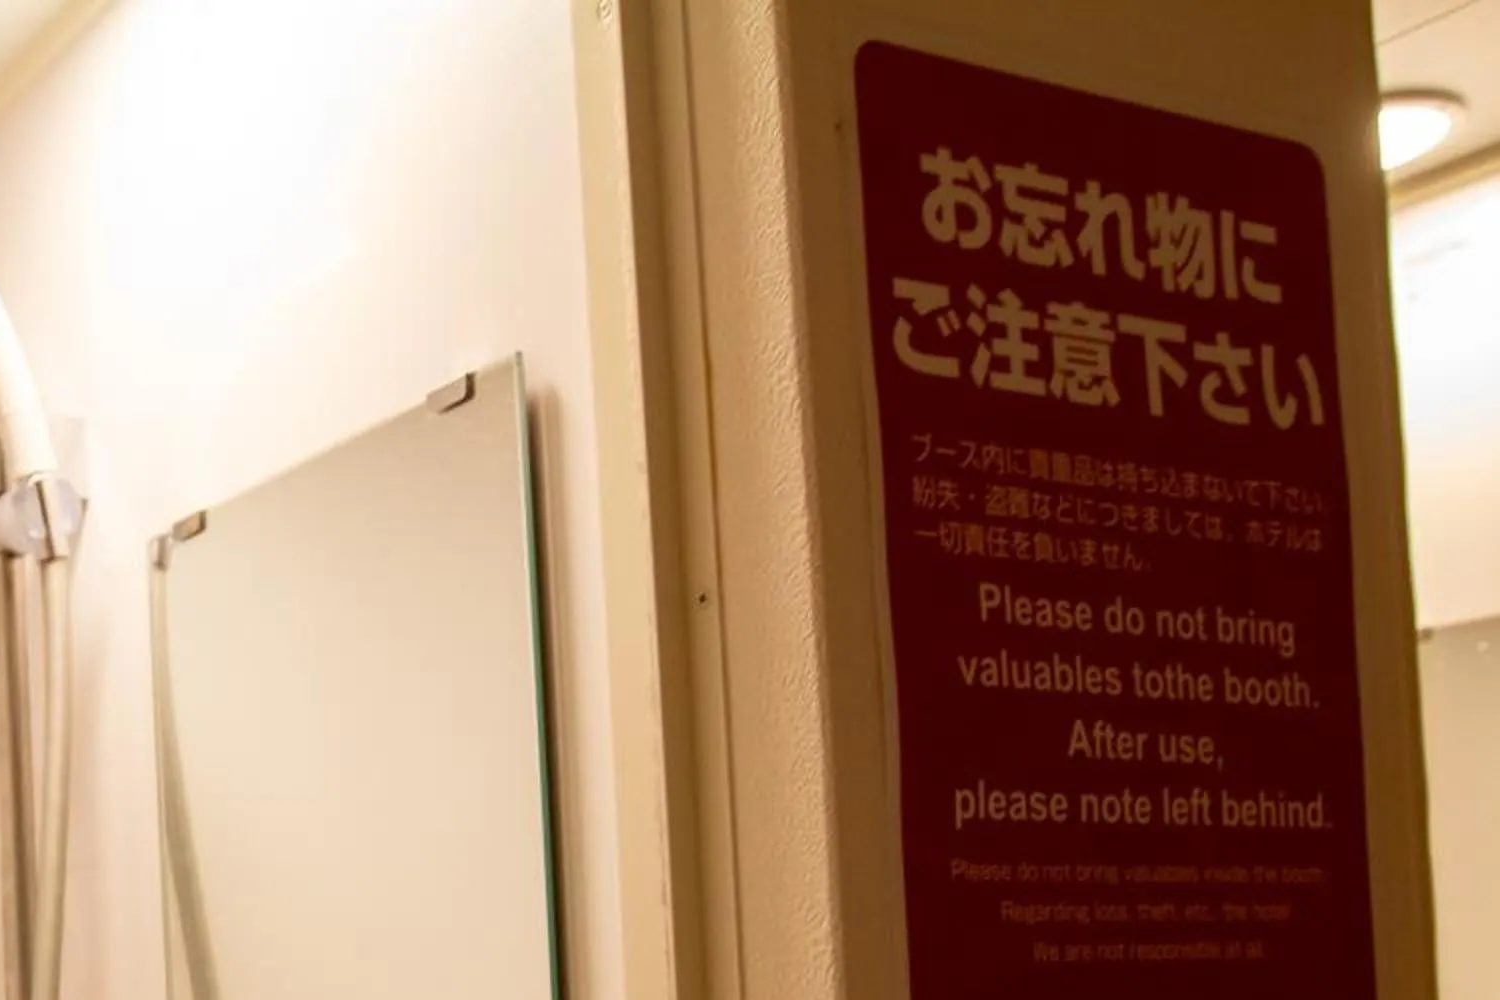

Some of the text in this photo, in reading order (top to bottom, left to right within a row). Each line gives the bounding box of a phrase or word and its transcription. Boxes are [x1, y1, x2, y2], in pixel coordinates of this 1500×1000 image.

[919, 146, 1282, 304] お忘れ物に
[892, 276, 1325, 430] ご注意下さい
[979, 582, 1296, 658] Please do not bring
[957, 649, 1320, 708] valuables tothe booth.
[1068, 720, 1225, 771] After use,
[955, 779, 1333, 830] please note left behind.
[949, 857, 1012, 883] Please
[1017, 861, 1040, 883] do
[1041, 862, 1071, 883] not
[1075, 862, 1120, 886] bring
[1123, 863, 1200, 884] valuables
[1000, 900, 1091, 926] Regarding
[1033, 941, 1059, 963] We
[1063, 944, 1092, 963] are
[1097, 943, 1124, 963] not
